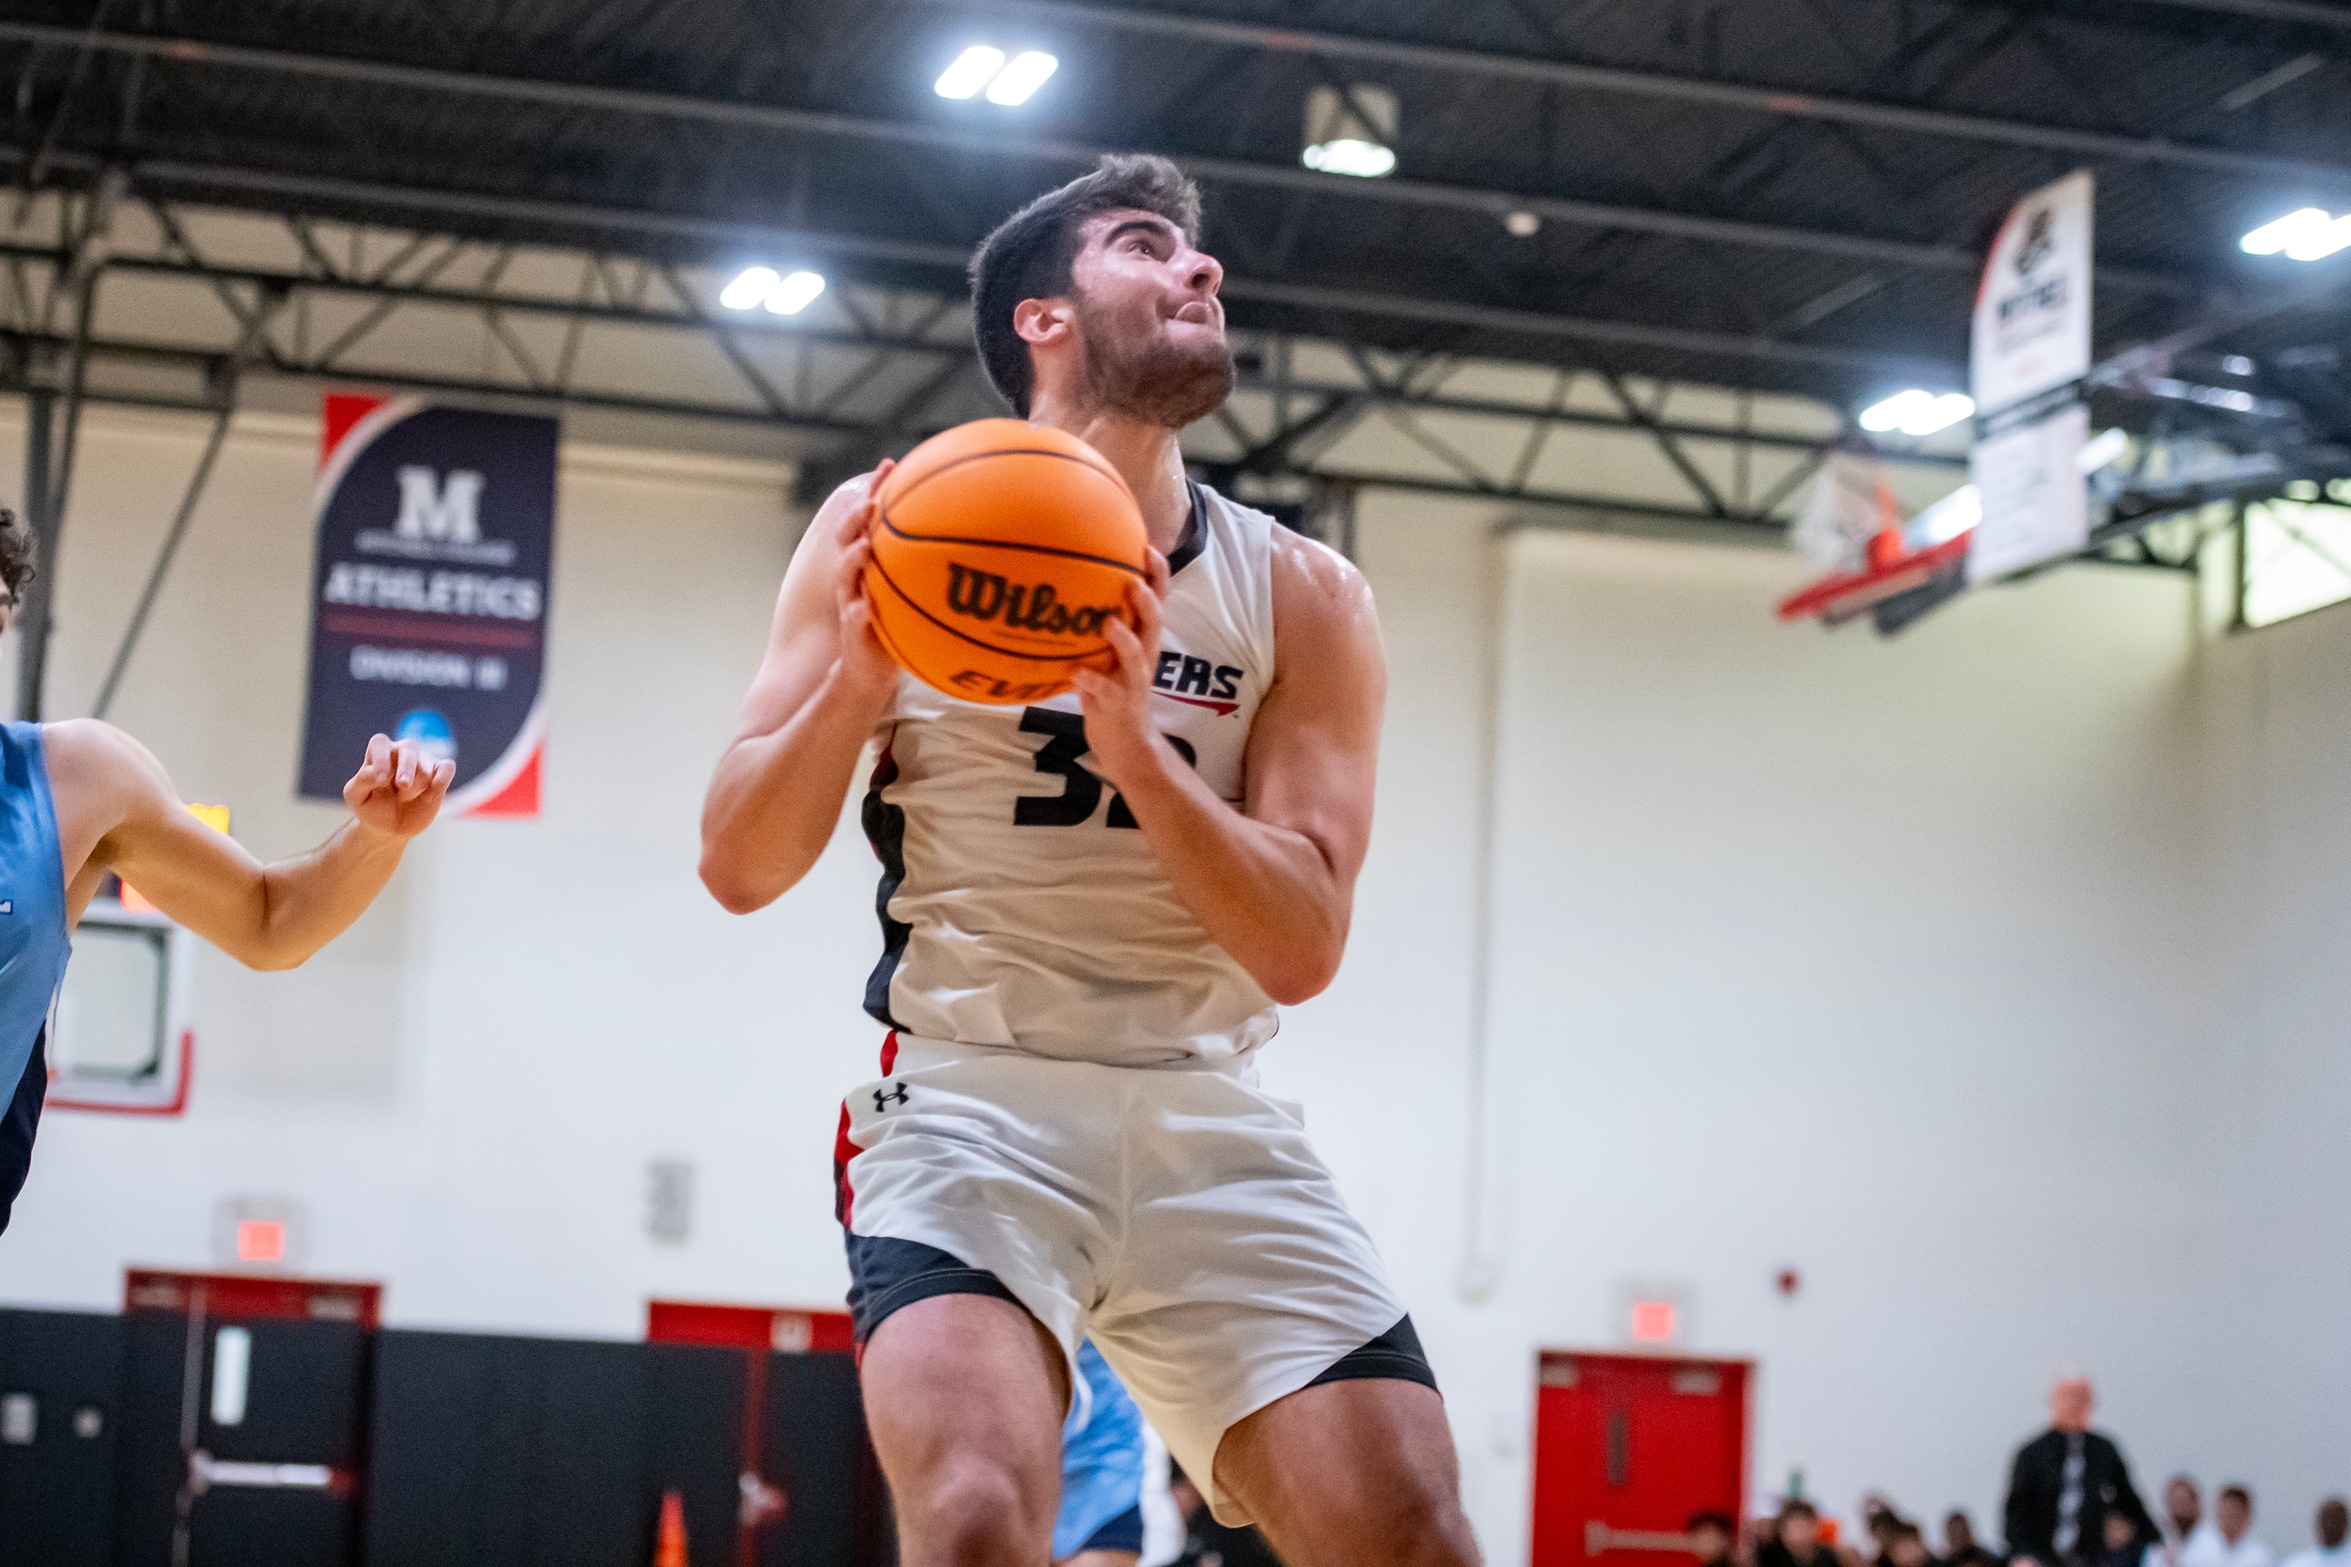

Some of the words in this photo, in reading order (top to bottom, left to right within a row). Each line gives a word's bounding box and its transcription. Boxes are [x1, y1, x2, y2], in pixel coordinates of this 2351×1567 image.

[395, 465, 487, 542] M
[326, 563, 541, 620] ATHLETICS
[350, 645, 471, 688] DIVISION
[1153, 651, 1243, 700] ERS
